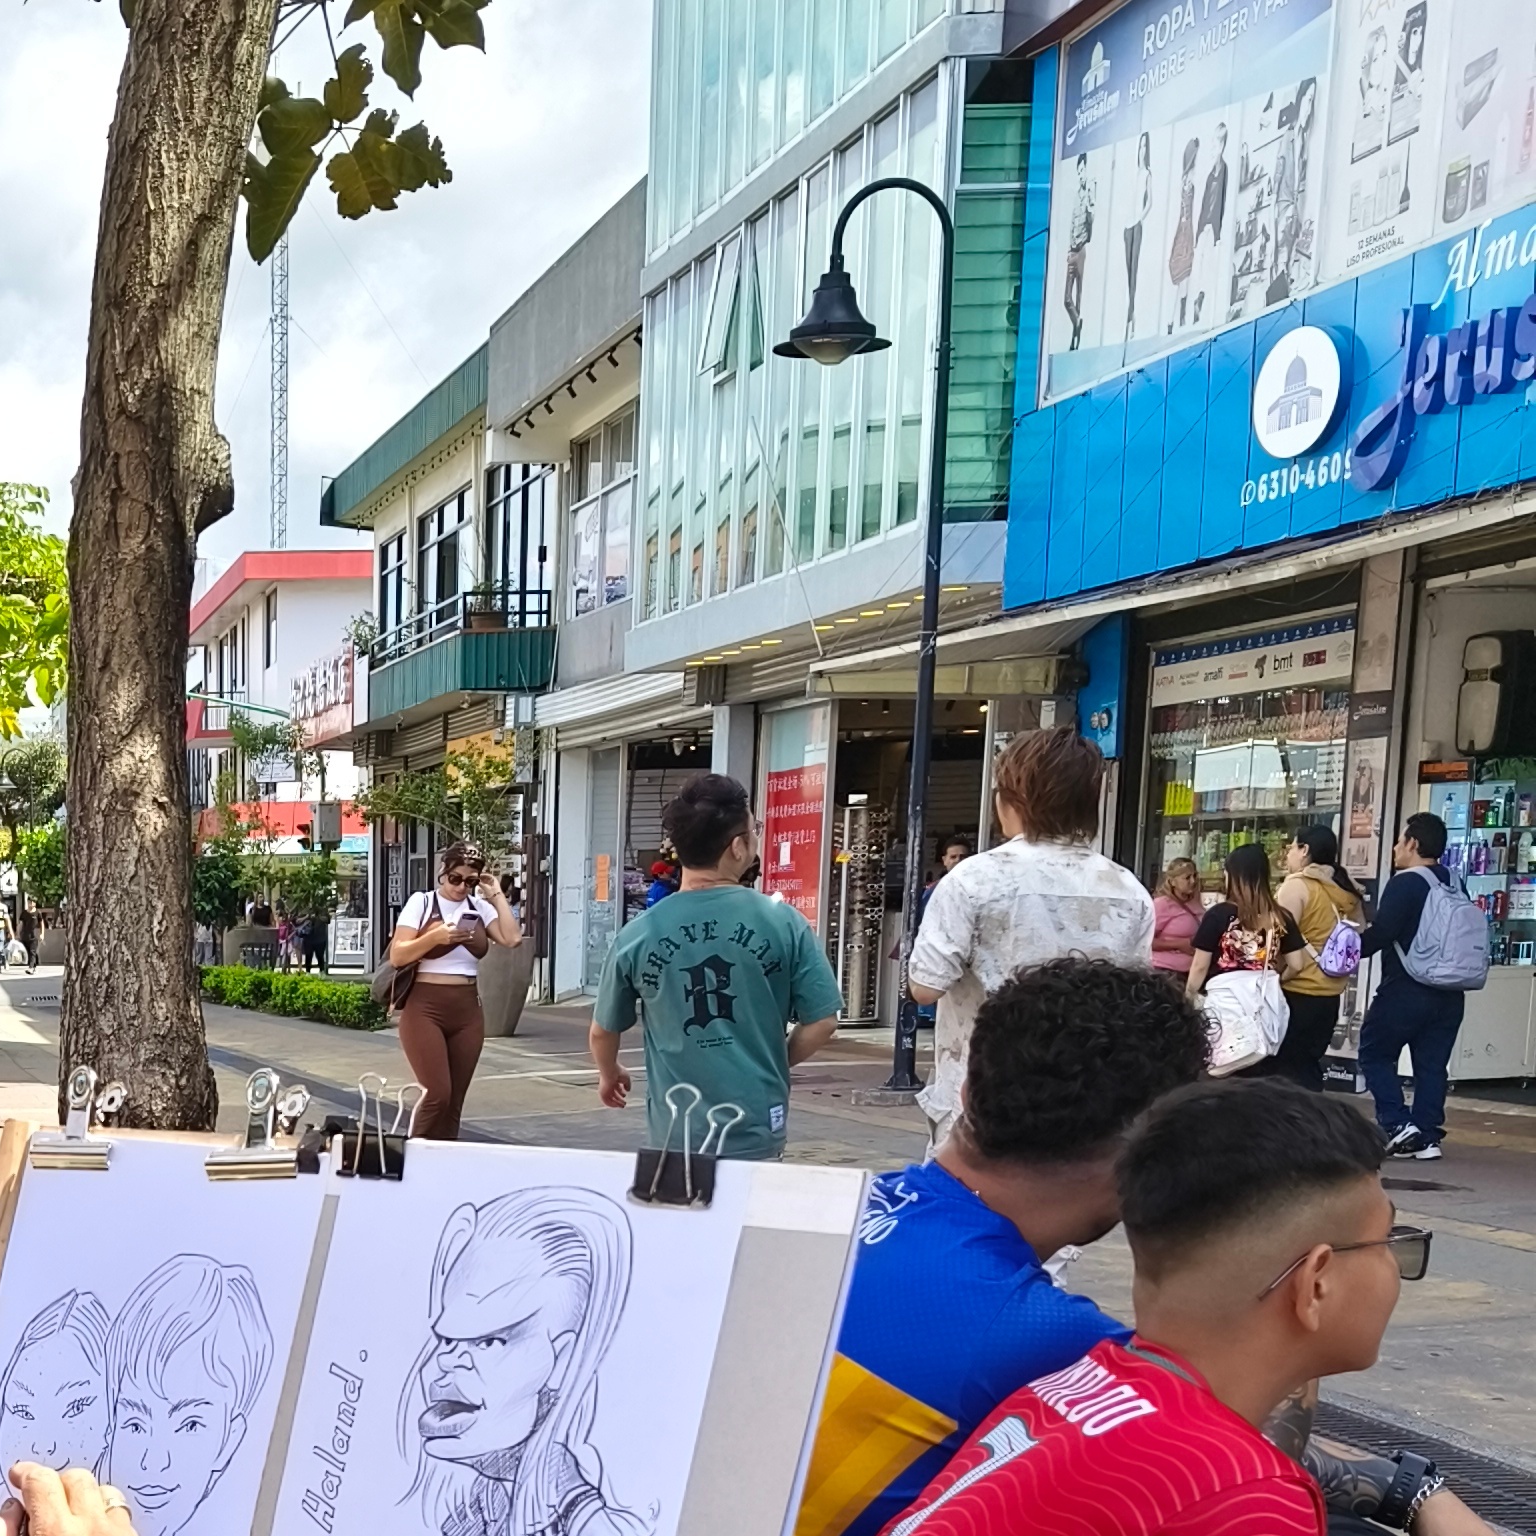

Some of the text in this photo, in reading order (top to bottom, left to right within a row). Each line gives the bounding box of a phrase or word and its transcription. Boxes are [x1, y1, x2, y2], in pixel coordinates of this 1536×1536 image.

[1128, 45, 1187, 105] HOMBRE
[1198, 7, 1249, 60] MUJER
[1253, 2, 1263, 25] Y
[1142, 0, 1196, 61] ROPA
[1346, 237, 1405, 268] LISO PROFESIONAL
[1364, 226, 1396, 248] SEMANAS
[641, 918, 720, 991] BRAVE
[678, 953, 738, 1037] B
